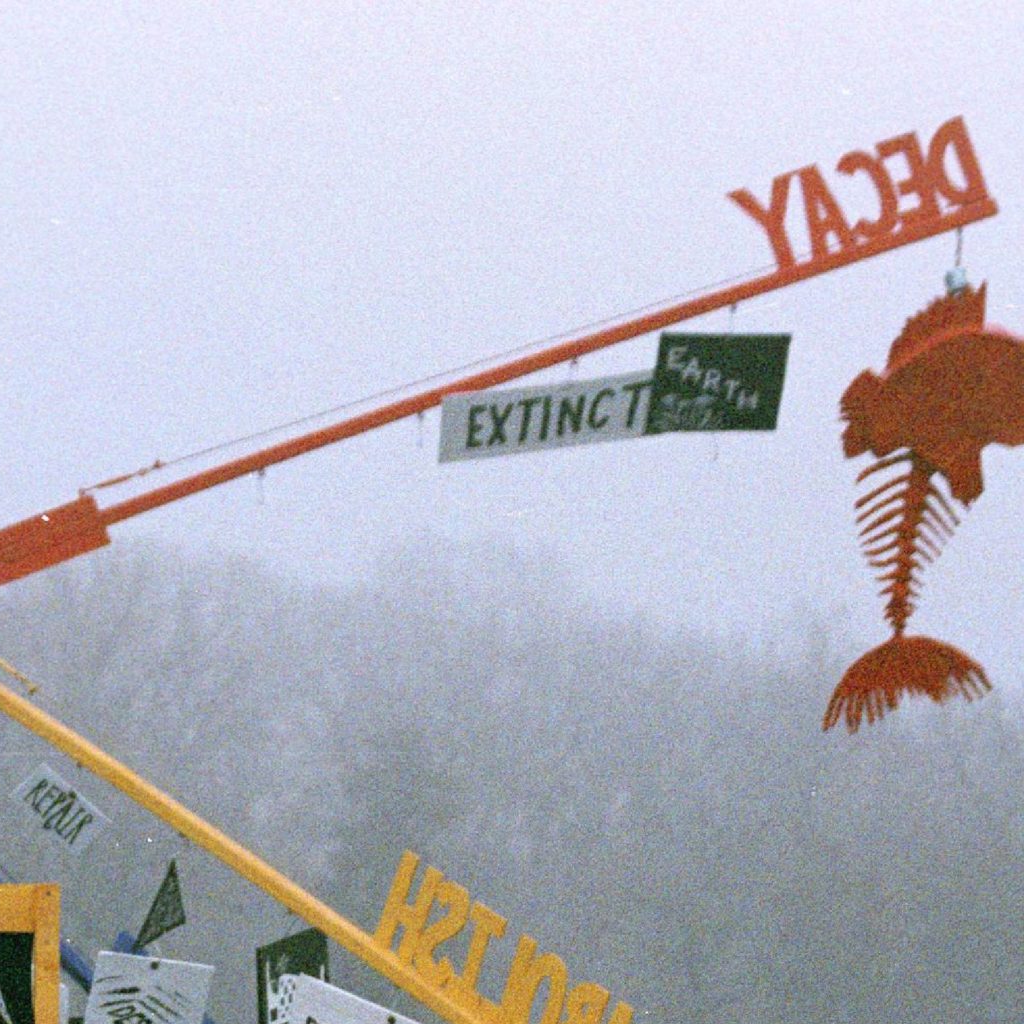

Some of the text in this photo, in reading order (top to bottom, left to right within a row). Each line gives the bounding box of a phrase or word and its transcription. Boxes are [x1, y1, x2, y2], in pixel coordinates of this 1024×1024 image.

[667, 346, 760, 411] EARTH
[466, 381, 654, 449] EXTINCT
[23, 778, 94, 845] REPAIR
